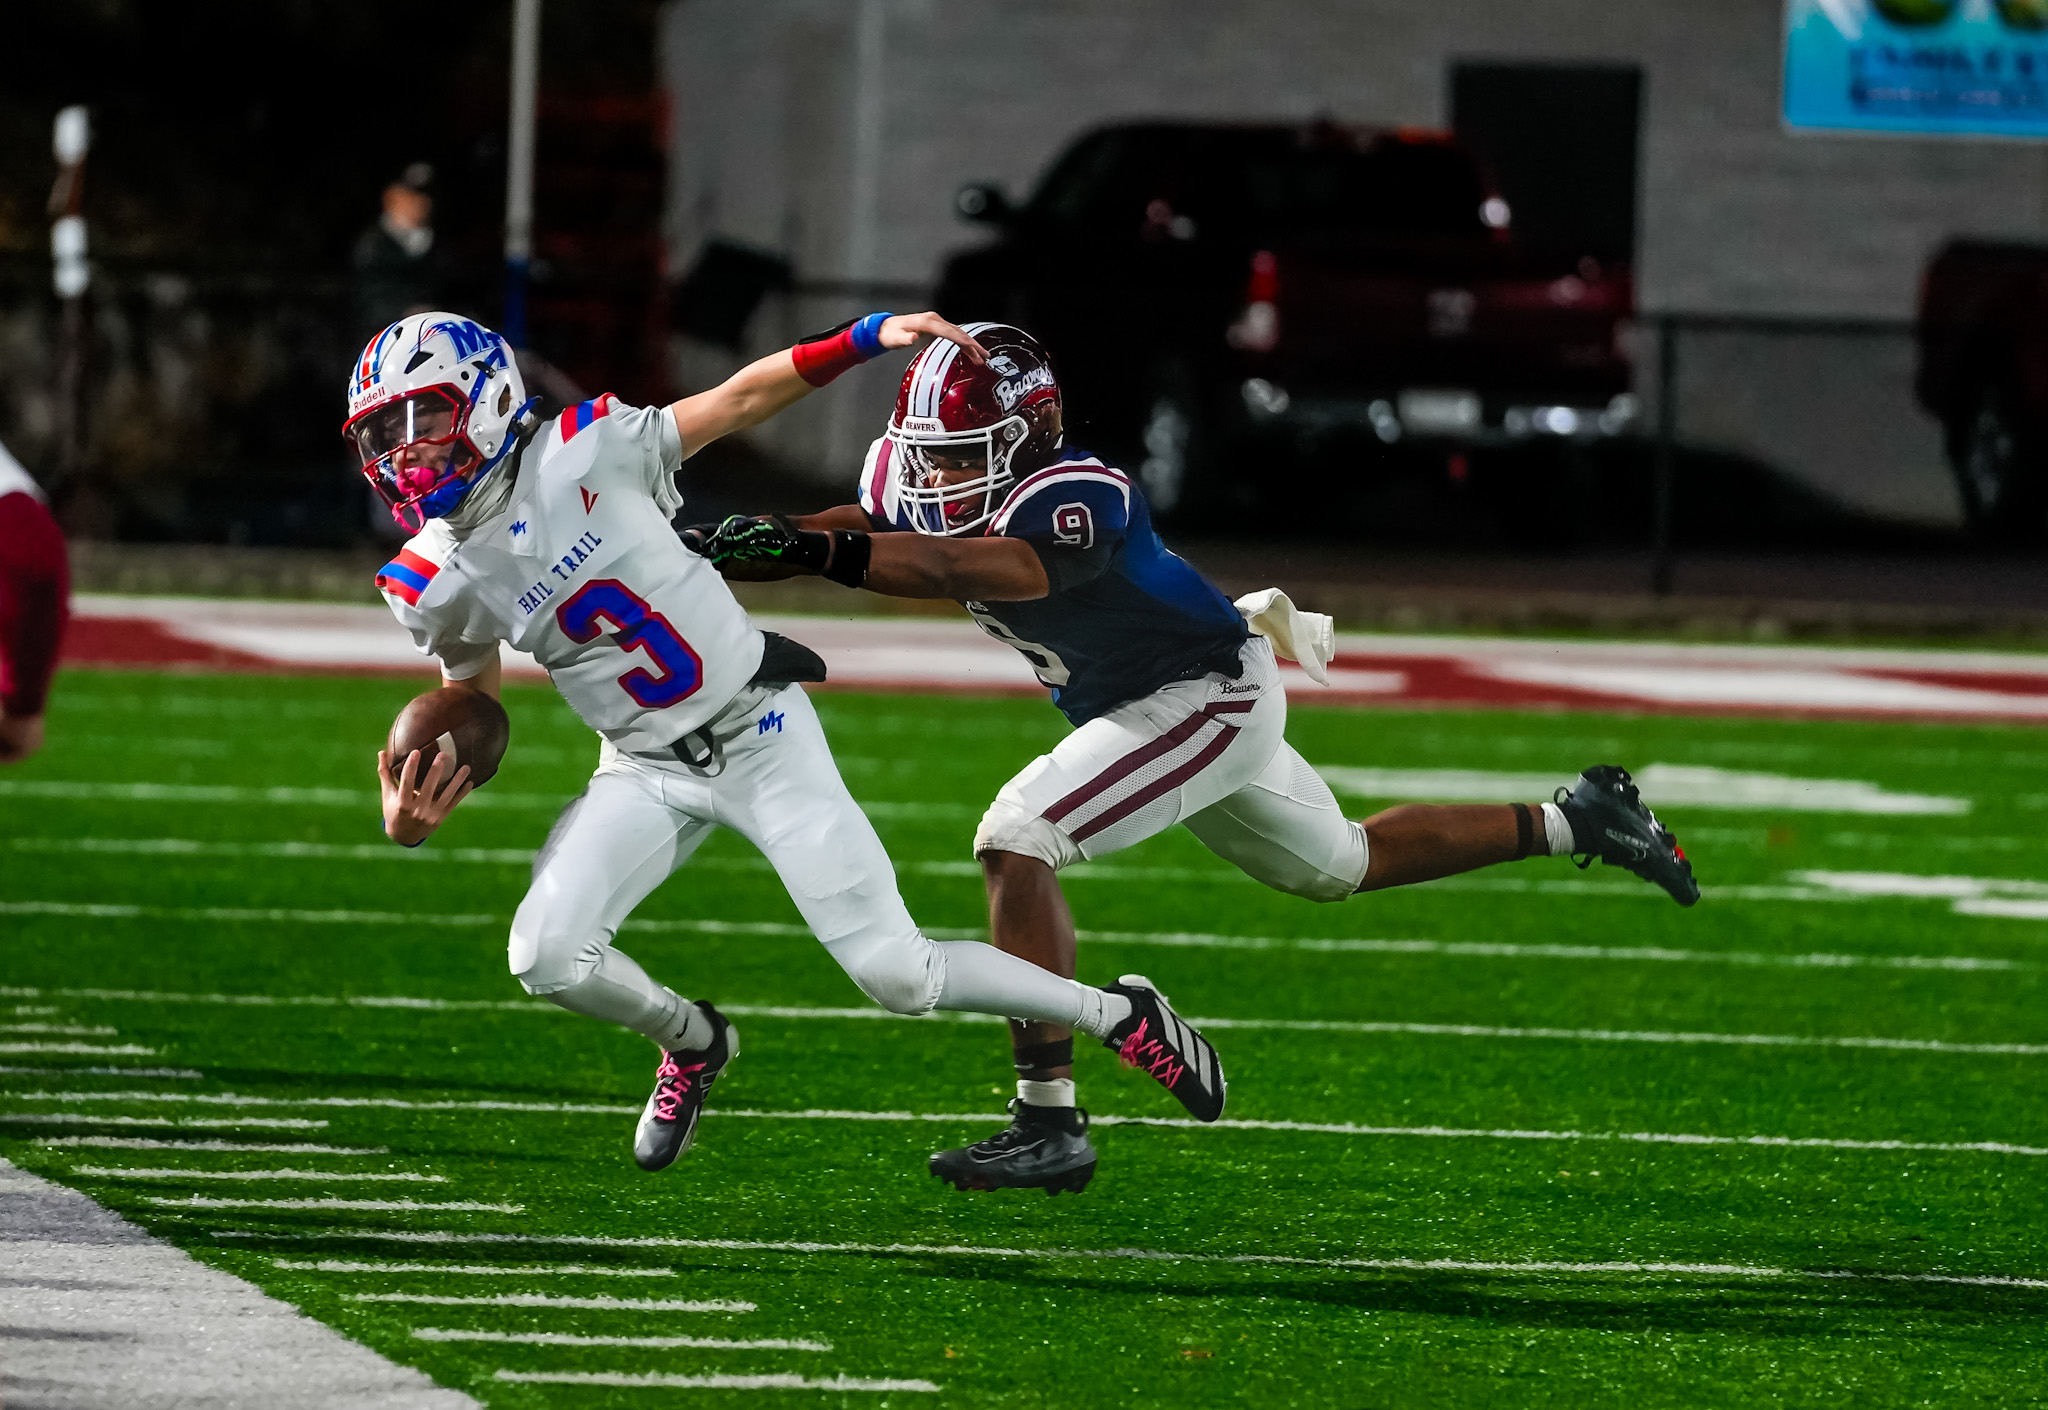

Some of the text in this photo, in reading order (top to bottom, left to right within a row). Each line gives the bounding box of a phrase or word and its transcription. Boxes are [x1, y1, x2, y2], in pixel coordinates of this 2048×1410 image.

[353, 386, 386, 412] Riddell
[905, 421, 936, 432] BEAVERS
[906, 448, 928, 483] Riddell
[1051, 502, 1095, 550] 9
[517, 531, 603, 616] HAIL TRAIL
[555, 578, 704, 709] 3
[757, 709, 786, 736] MT
